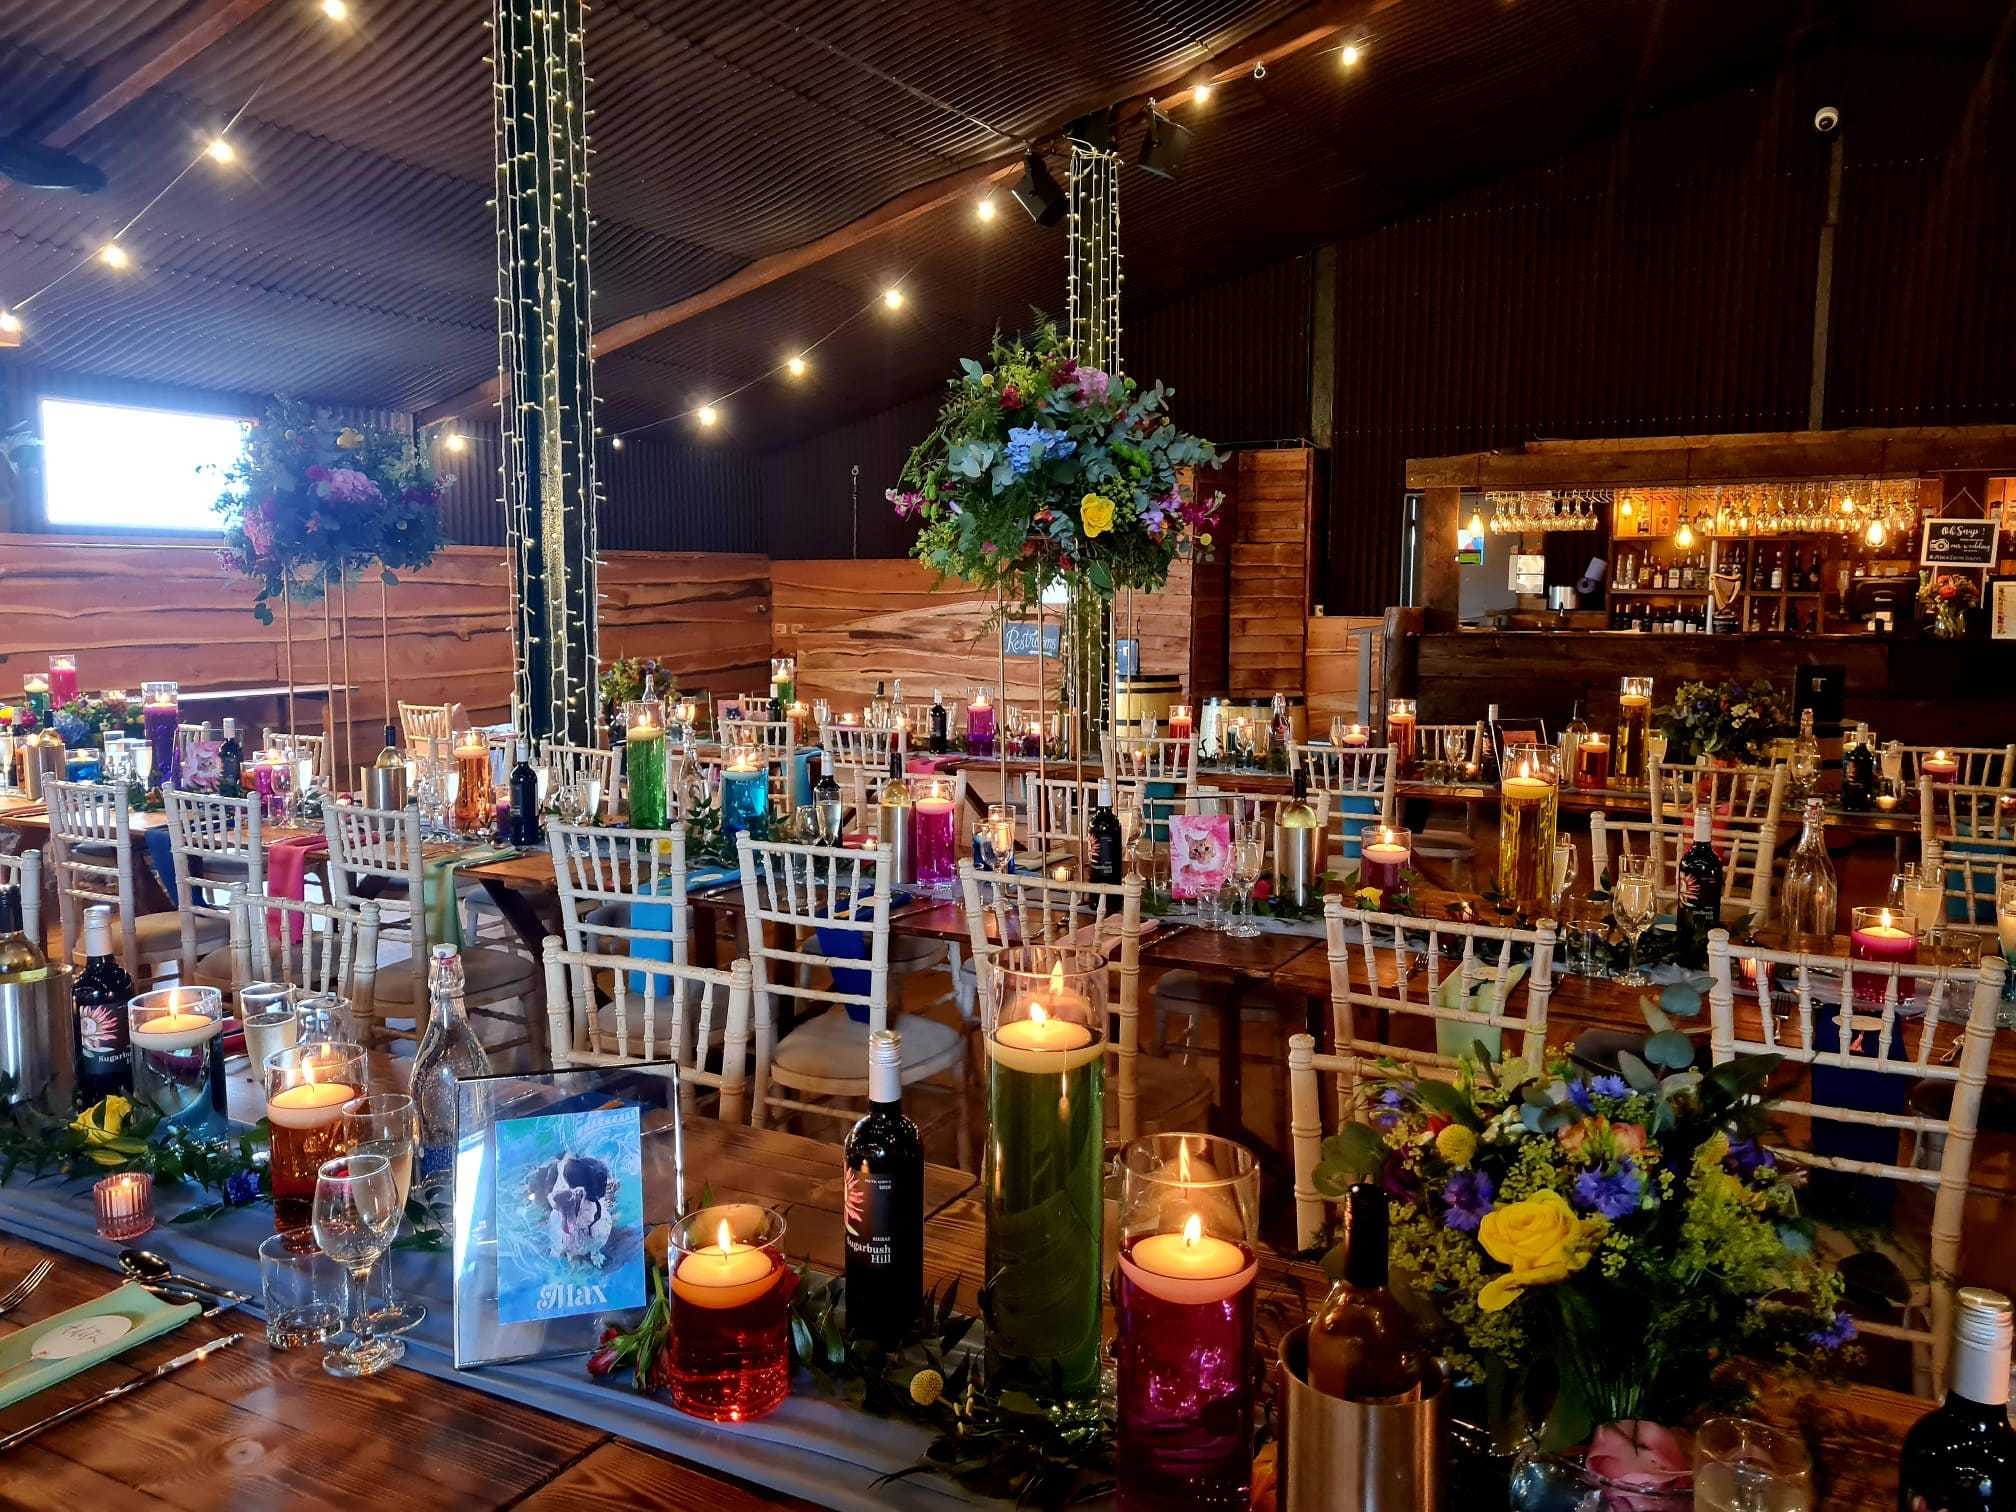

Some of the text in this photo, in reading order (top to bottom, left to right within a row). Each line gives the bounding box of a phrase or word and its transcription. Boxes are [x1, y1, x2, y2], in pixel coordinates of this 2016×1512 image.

[1006, 626, 1057, 654] Restroms
[846, 1236, 891, 1254] Sugarbush
[871, 1254, 891, 1264] Hill
